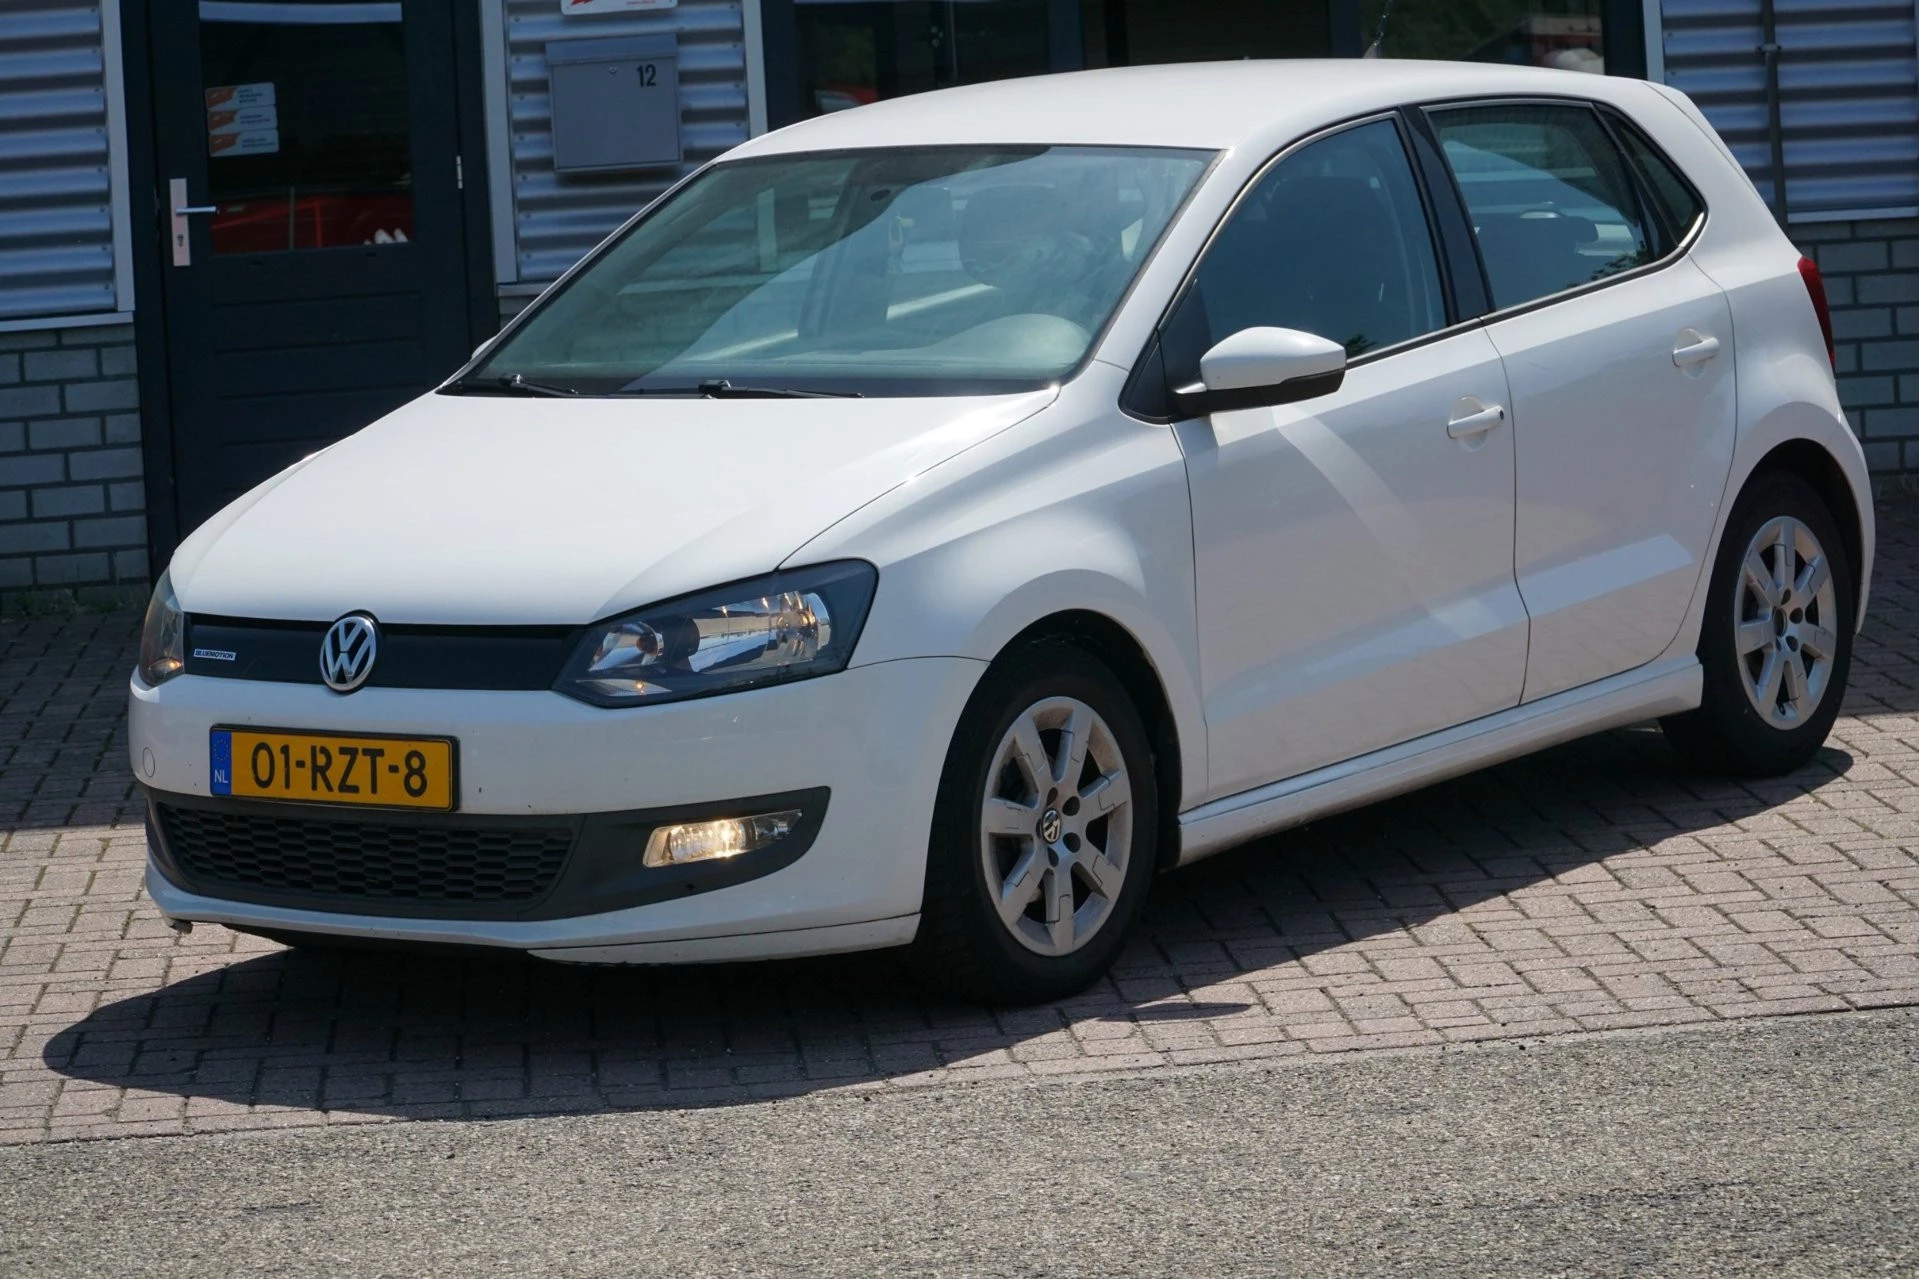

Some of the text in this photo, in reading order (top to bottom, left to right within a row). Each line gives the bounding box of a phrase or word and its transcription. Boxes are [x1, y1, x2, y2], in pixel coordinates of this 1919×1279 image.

[637, 64, 657, 88] 12
[194, 649, 235, 660] BLUEMOTION
[320, 615, 377, 692] VW
[214, 769, 229, 784] NL
[252, 741, 428, 798] 01-RZT-8
